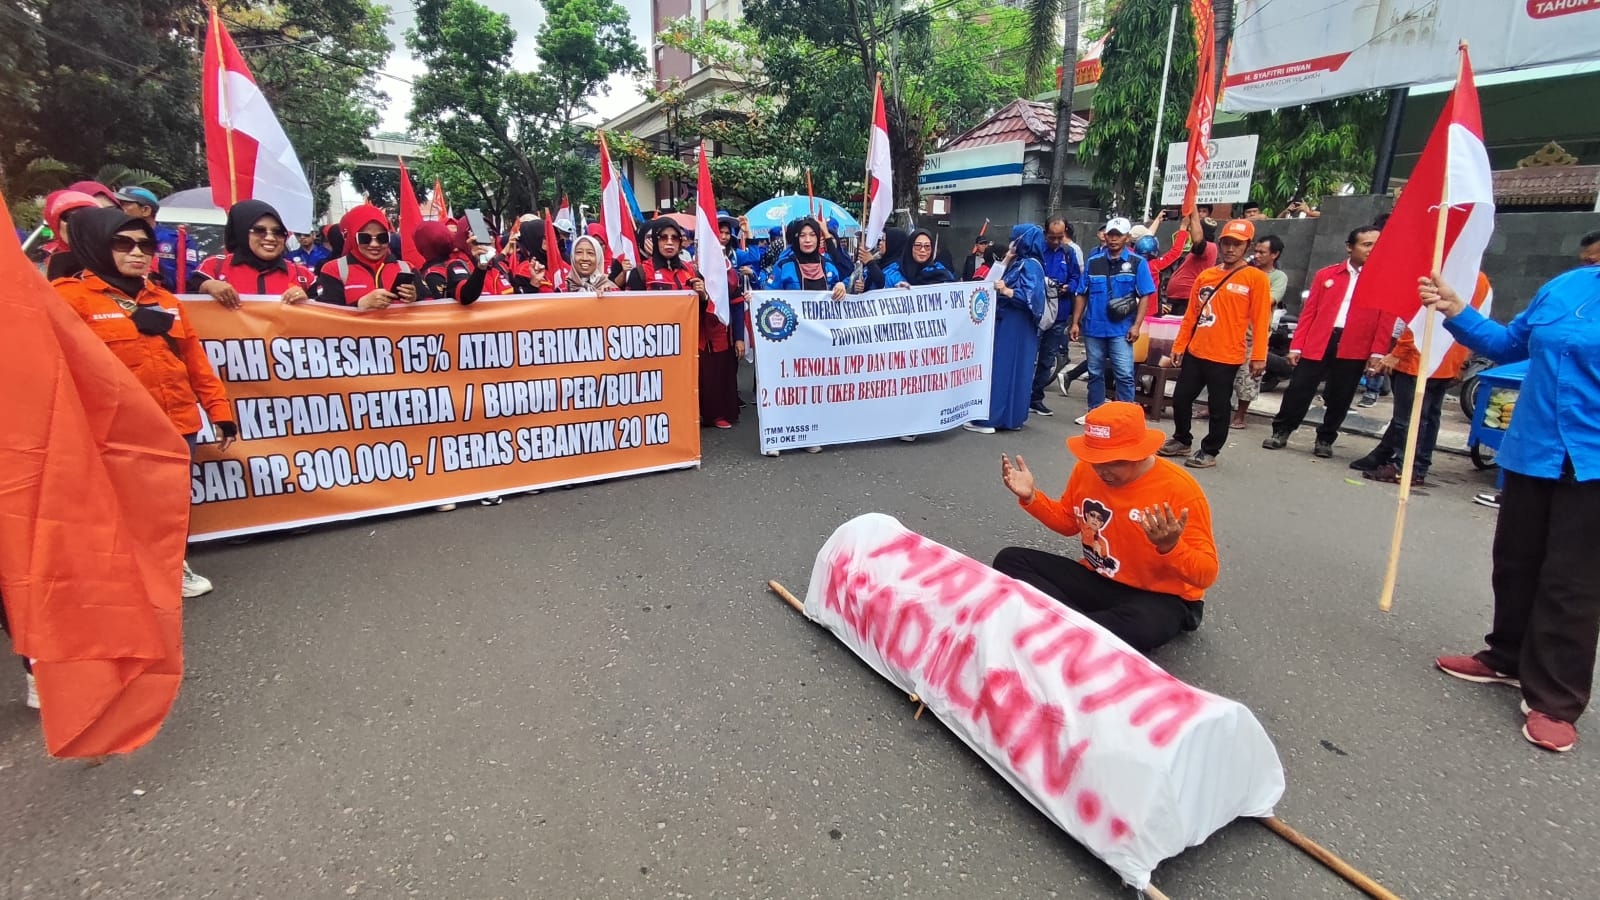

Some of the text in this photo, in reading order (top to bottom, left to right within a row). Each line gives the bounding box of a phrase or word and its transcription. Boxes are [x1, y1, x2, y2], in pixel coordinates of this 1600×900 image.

[1253, 68, 1284, 80] SYAFITRI
[1286, 63, 1311, 74] IRWAN
[925, 156, 941, 170] BNI
[1213, 160, 1247, 169] PERSATUAN
[801, 299, 842, 321] FEDERASI
[842, 298, 880, 320] SERIKAT
[880, 295, 915, 316] PEKERJA
[916, 292, 942, 313] RTMM
[949, 290, 965, 309] SPSI
[830, 318, 947, 347] PROVINSI SUMATERA SELATAN
[200, 323, 681, 382] PAH SEBESAR 15% ATAU BERIKAN SUBSIDI
[780, 359, 789, 378] 1.
[793, 356, 840, 378] MENOLAK
[844, 354, 864, 374] UMP
[867, 352, 885, 373] DAN
[888, 350, 906, 370] UMK
[909, 349, 918, 368] SE
[921, 345, 948, 366] SUMSEL
[761, 388, 771, 408] 2.
[775, 386, 808, 406] CABUT
[811, 385, 823, 405] UU
[826, 382, 855, 403] CIKER
[858, 378, 897, 401] BESERTA
[900, 371, 948, 396] PERATURAN
[236, 393, 349, 441] KEPADA
[350, 386, 456, 430] PEKERJA
[462, 383, 474, 421] /
[482, 377, 557, 419] BURUH
[560, 369, 662, 411] PER/BULAN
[764, 426, 784, 436] TMM
[785, 424, 810, 434] YASSS
[780, 434, 796, 443] OKE
[248, 454, 295, 498] RP.
[294, 440, 423, 492] 300.000,-
[426, 436, 438, 475] /
[441, 429, 515, 473] BERAS
[516, 419, 617, 464] SEBANYAK
[617, 415, 642, 450] 20
[644, 412, 670, 446] KG
